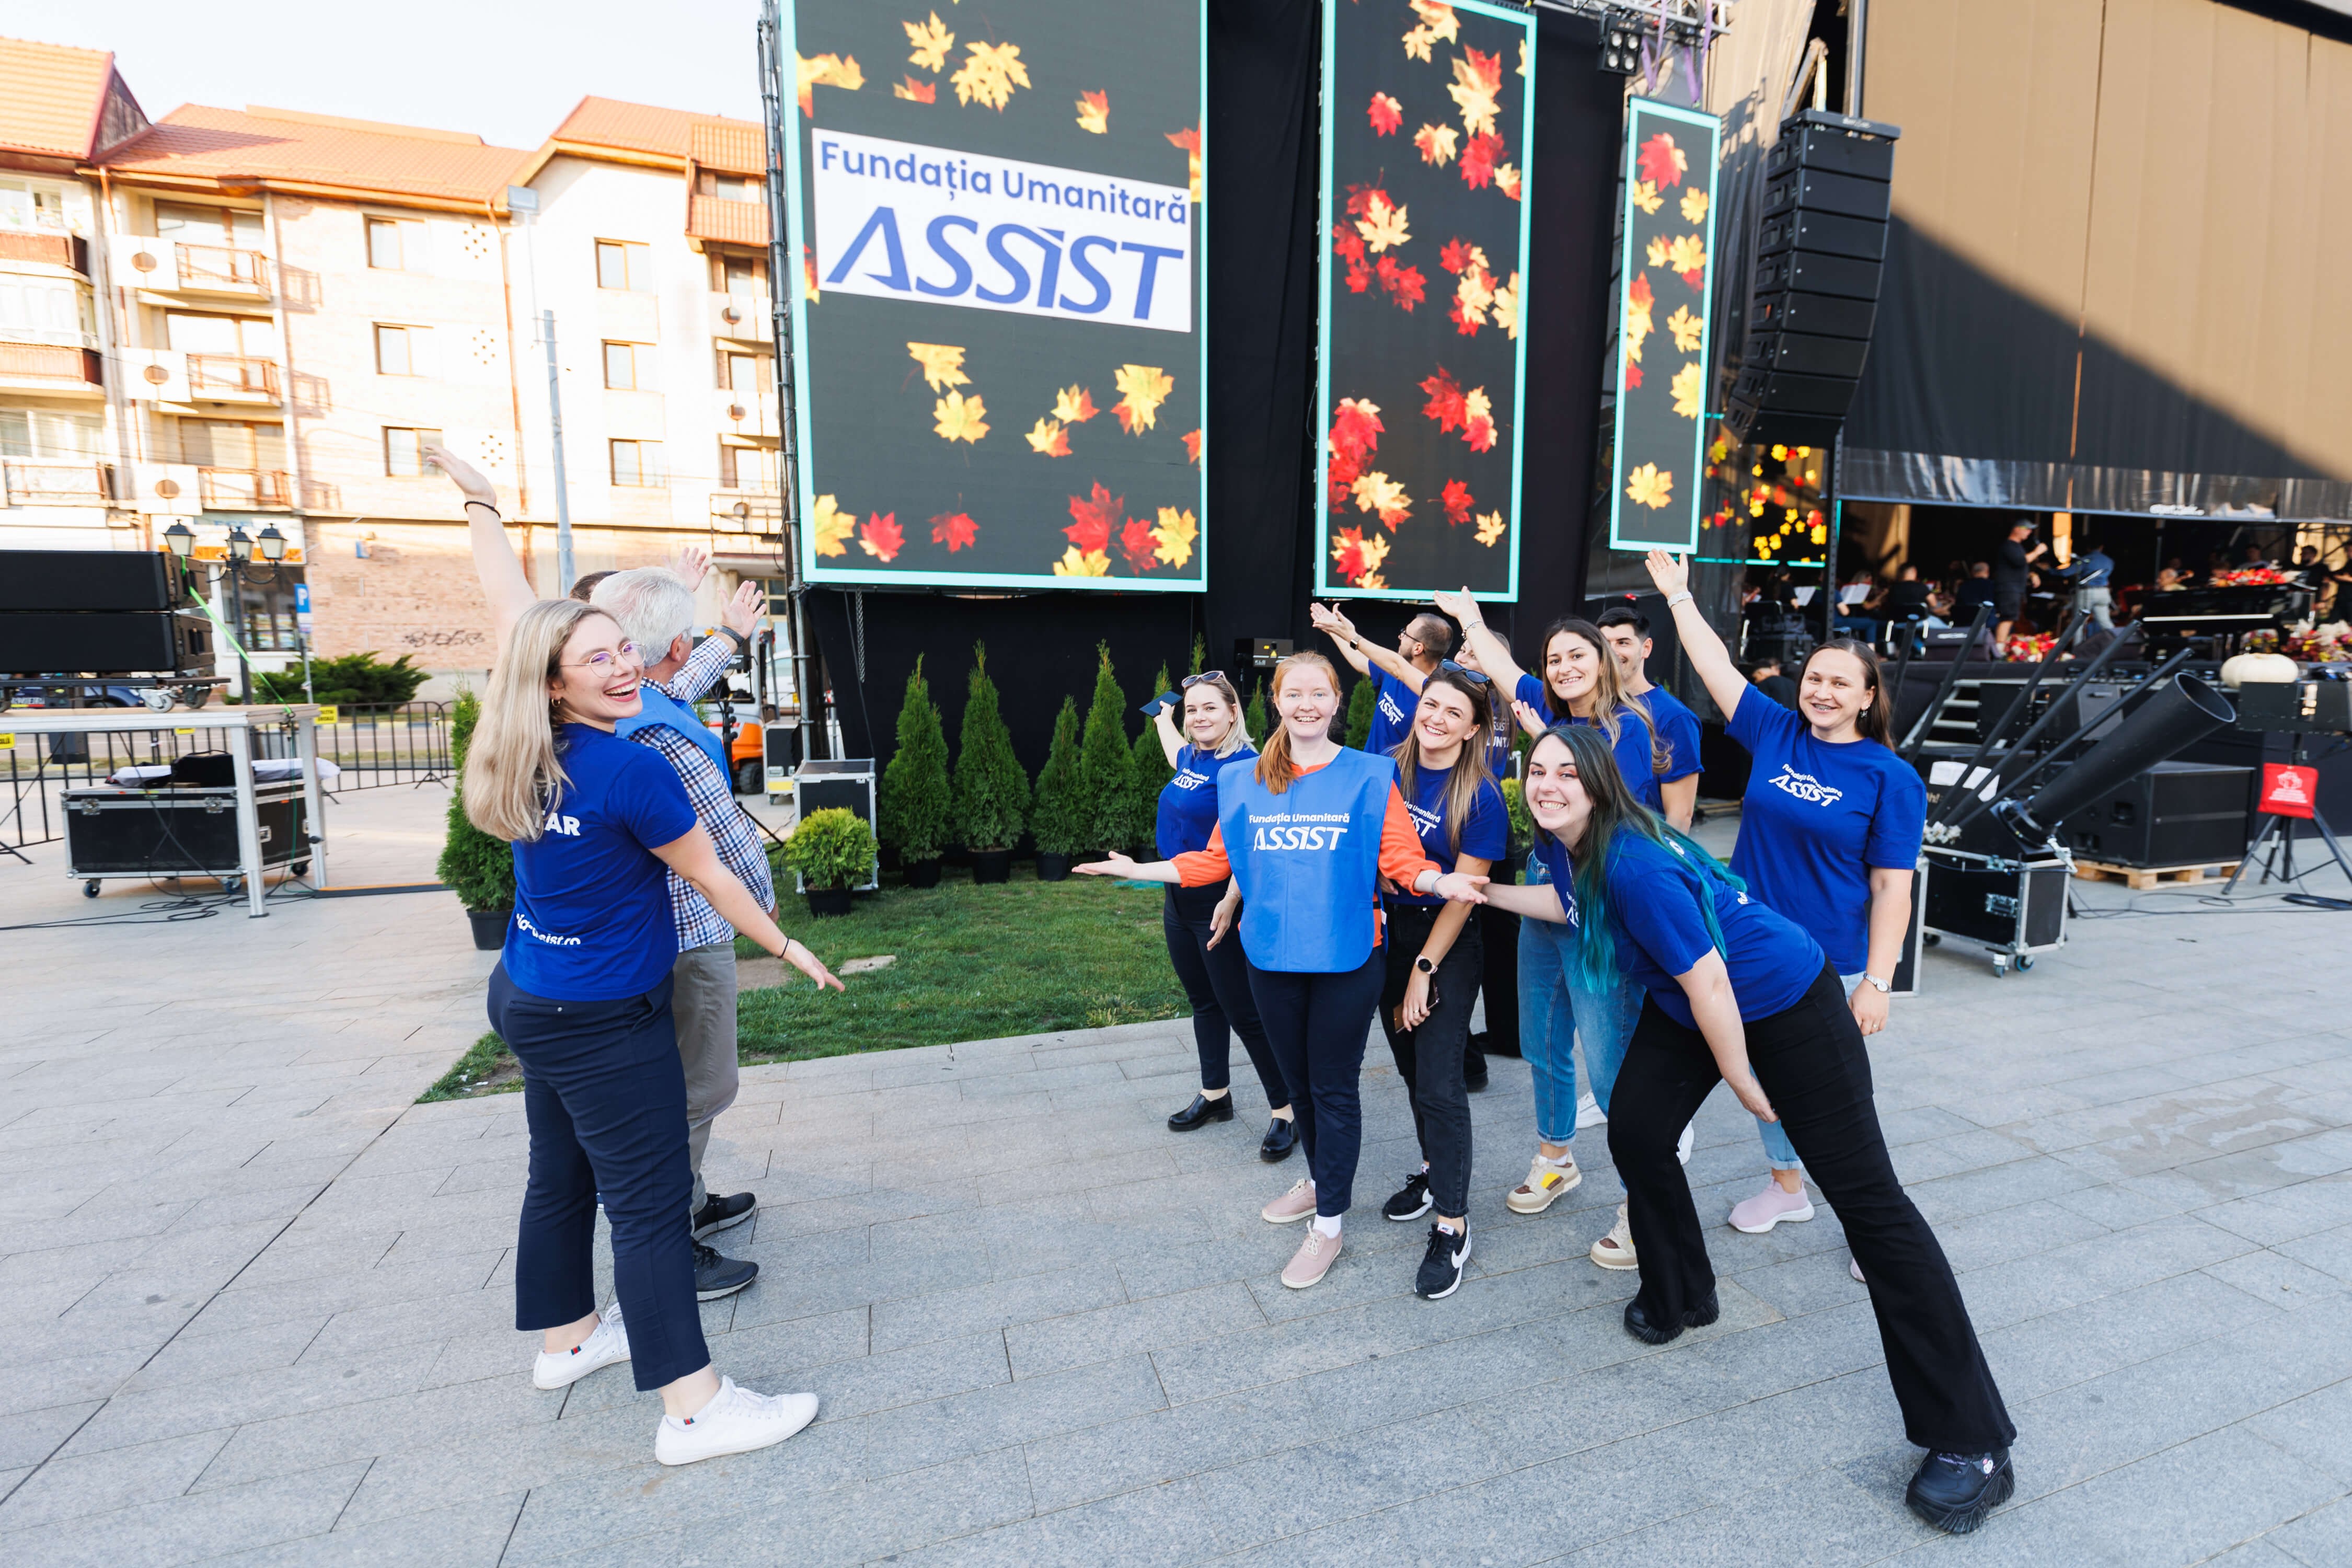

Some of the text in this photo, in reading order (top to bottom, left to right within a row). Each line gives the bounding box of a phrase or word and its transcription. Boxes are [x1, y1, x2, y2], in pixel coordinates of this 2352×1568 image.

[821, 141, 1186, 224] Fundația Umanitară
[825, 206, 1184, 320] ASSIST
[1768, 774, 1840, 806] ASSIST
[1248, 813, 1350, 825] Fundația Umanitară
[1253, 826, 1348, 851] ASSIST
